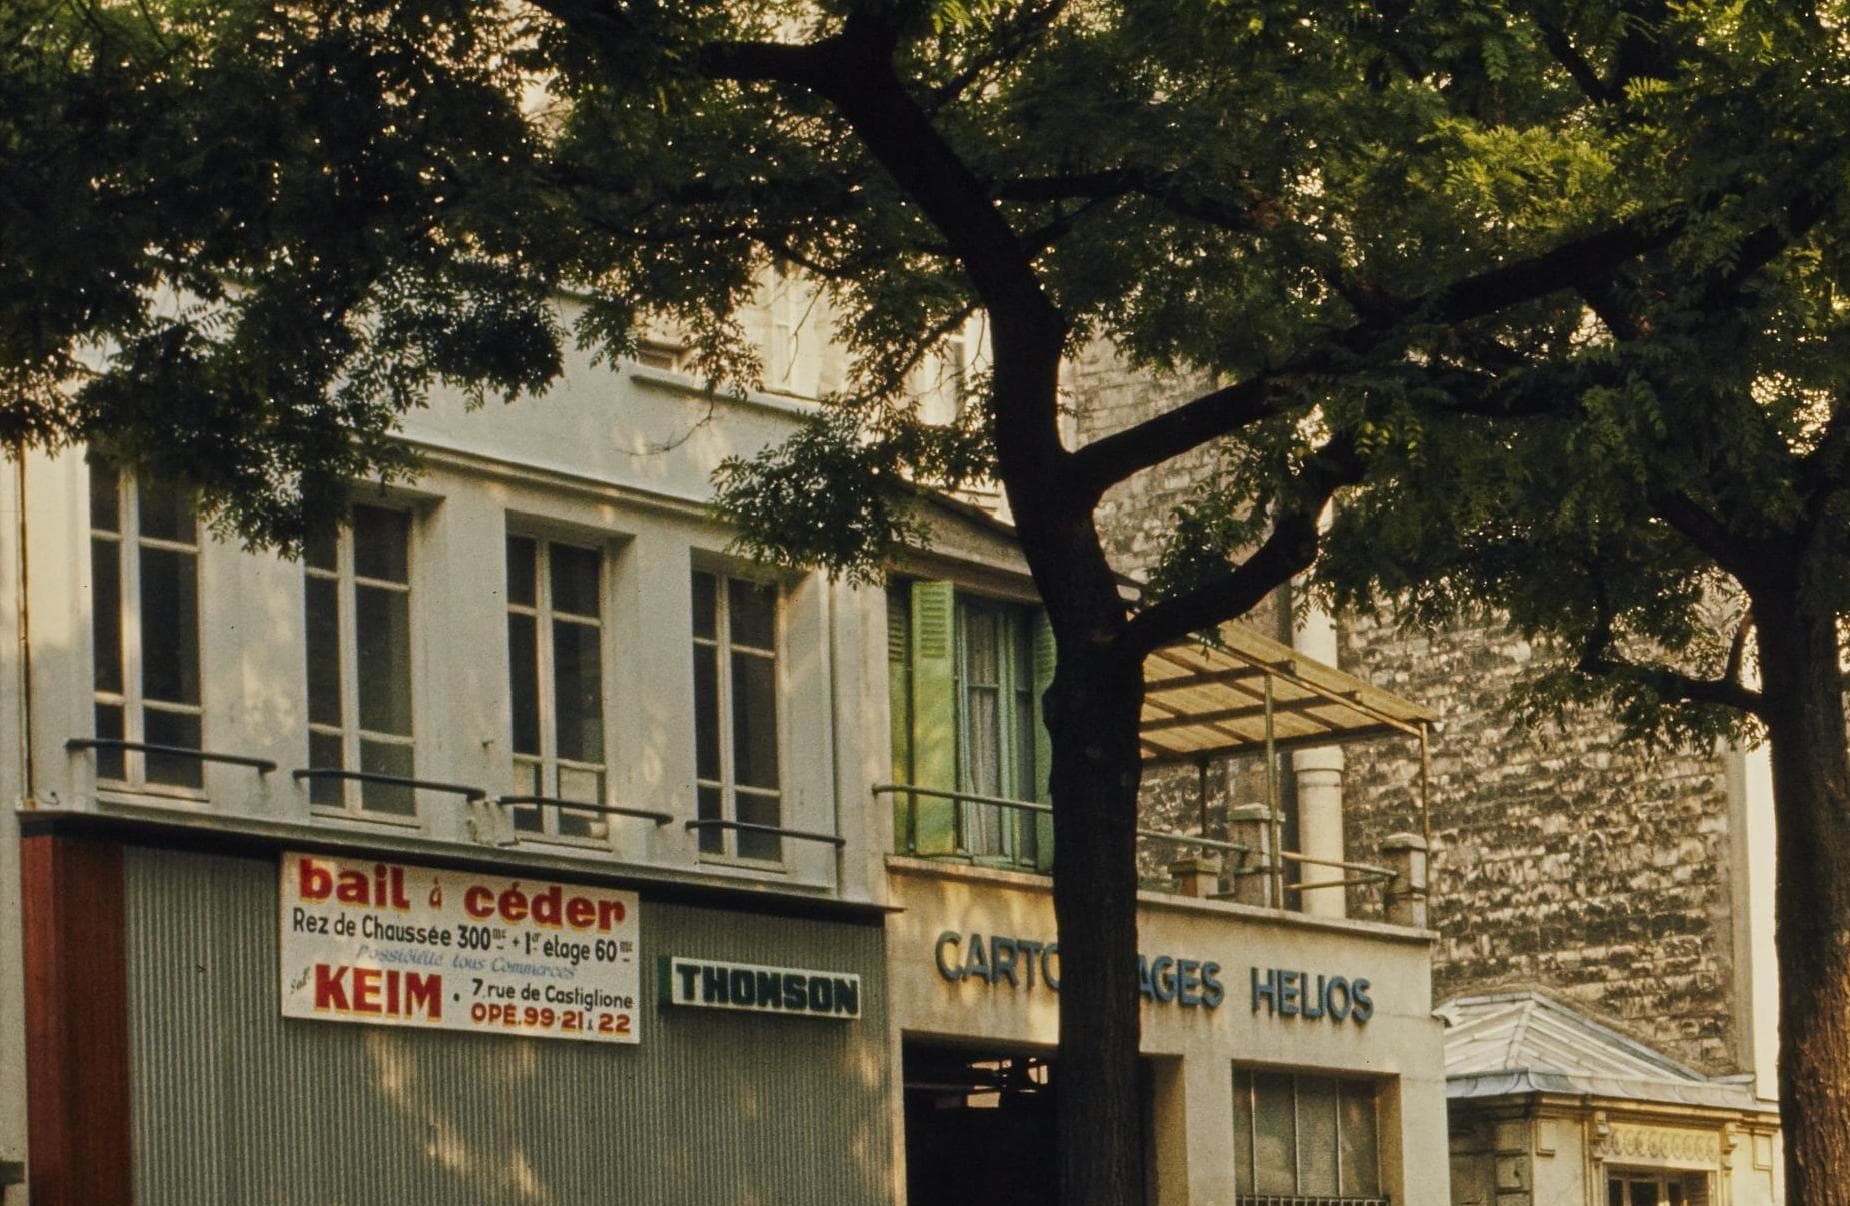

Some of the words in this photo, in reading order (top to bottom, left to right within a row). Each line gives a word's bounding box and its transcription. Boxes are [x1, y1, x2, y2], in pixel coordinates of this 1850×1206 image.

[299, 858, 411, 913] bail
[464, 881, 626, 934] céder
[293, 902, 328, 935] Rez
[334, 912, 356, 937] de
[362, 915, 451, 947] Chaussée
[315, 963, 442, 1024] KEIM
[472, 977, 484, 996] 7
[487, 984, 516, 1000] rue
[521, 983, 541, 1001] de
[545, 985, 633, 1012] Castiglione
[675, 963, 859, 1015] THOMSON
[935, 930, 1225, 1009] CARTOAGES
[1251, 965, 1374, 1024] HELIOS
[598, 1012, 631, 1037] 22
